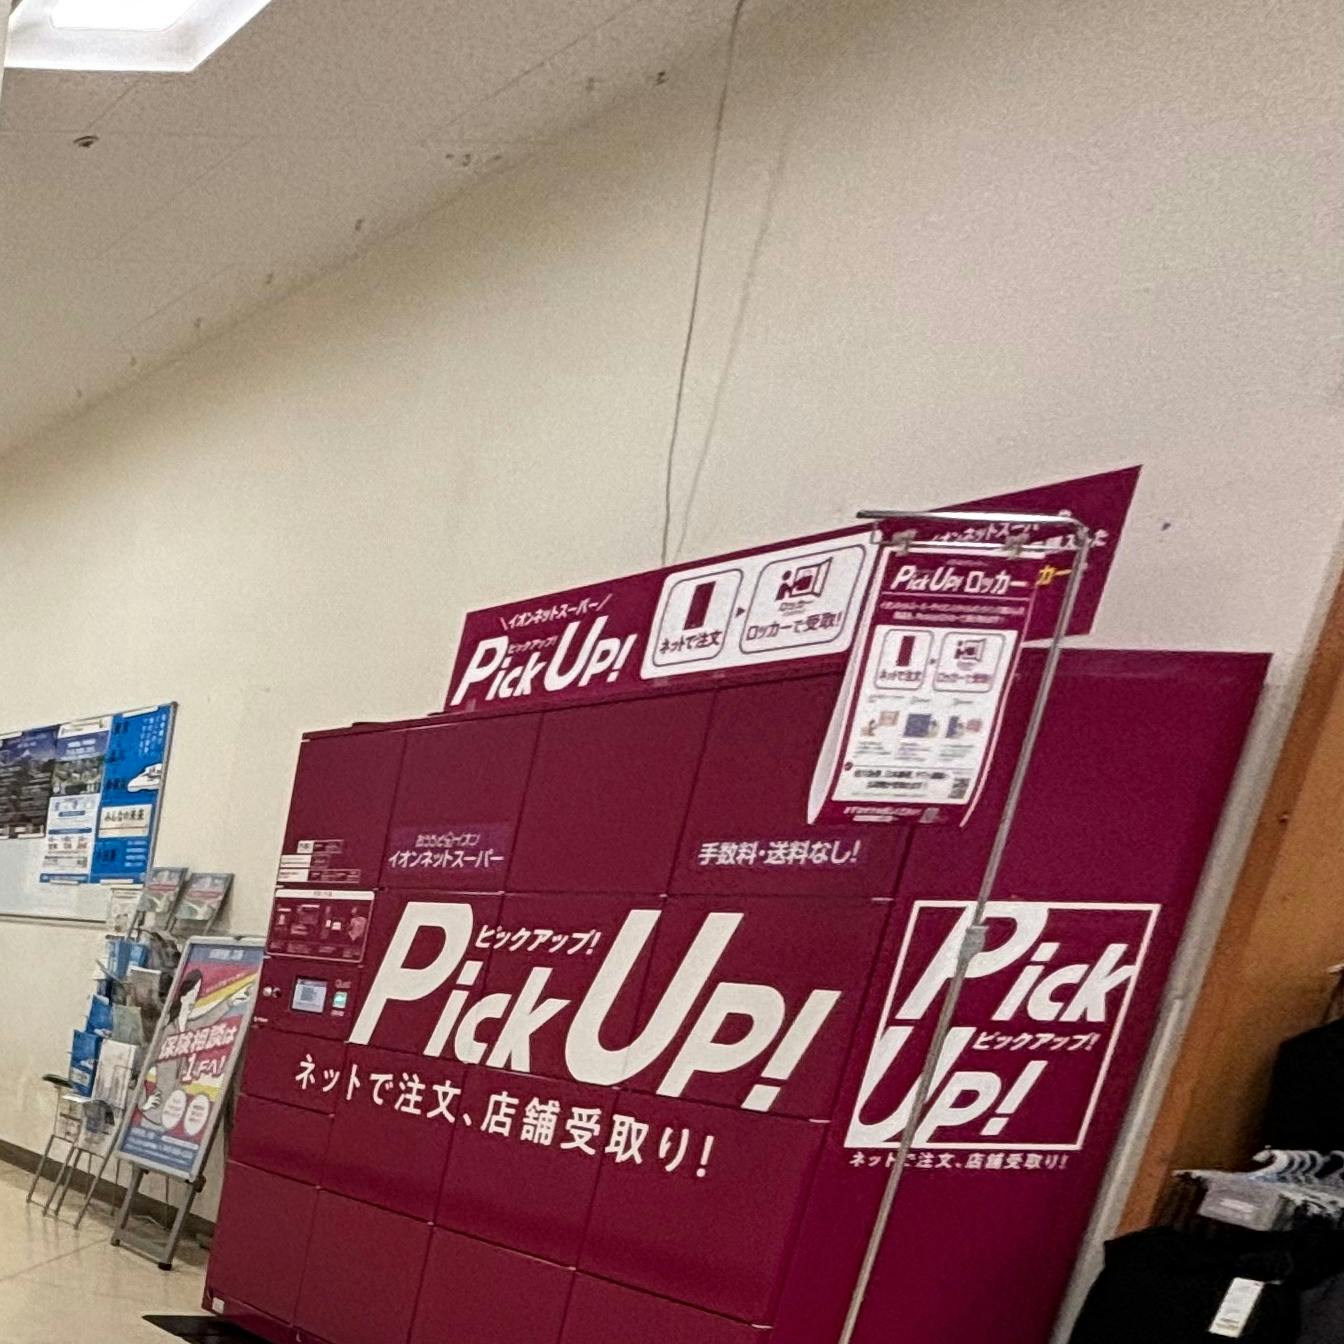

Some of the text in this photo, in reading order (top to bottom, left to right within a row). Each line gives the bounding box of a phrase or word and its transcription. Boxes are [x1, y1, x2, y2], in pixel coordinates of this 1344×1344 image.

[963, 569, 1029, 595] ロッカー
[388, 849, 505, 869] イオンネットスーパー
[698, 840, 862, 866] 手数料・送料なし!
[895, 901, 1138, 1023] Pick
[294, 1053, 716, 1179] ネットで注文、店舗受取り!
